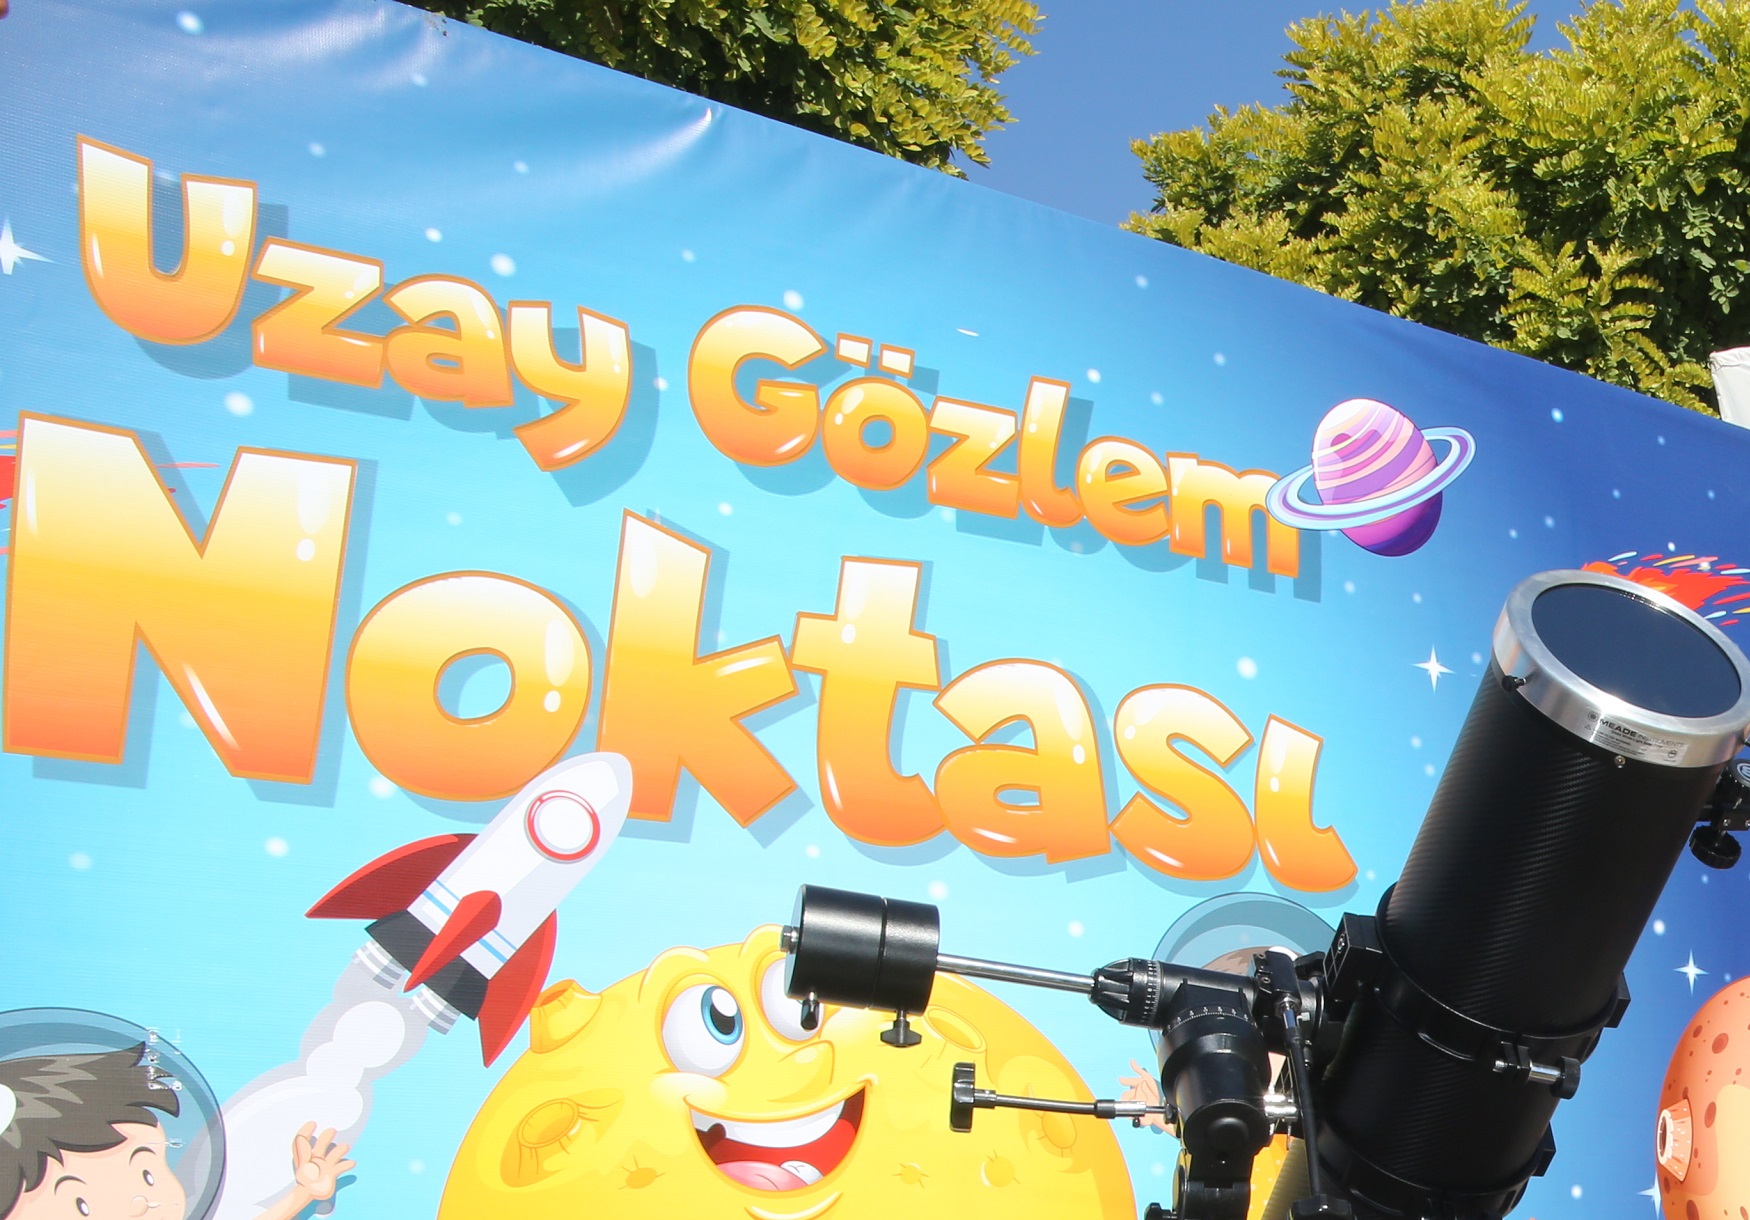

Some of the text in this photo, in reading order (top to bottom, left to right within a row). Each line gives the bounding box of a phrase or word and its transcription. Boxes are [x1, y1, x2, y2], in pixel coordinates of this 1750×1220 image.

[76, 133, 1301, 578] Uzay Gözlem
[2, 410, 1359, 893] Noktası
[1600, 718, 1637, 737] MEADE
